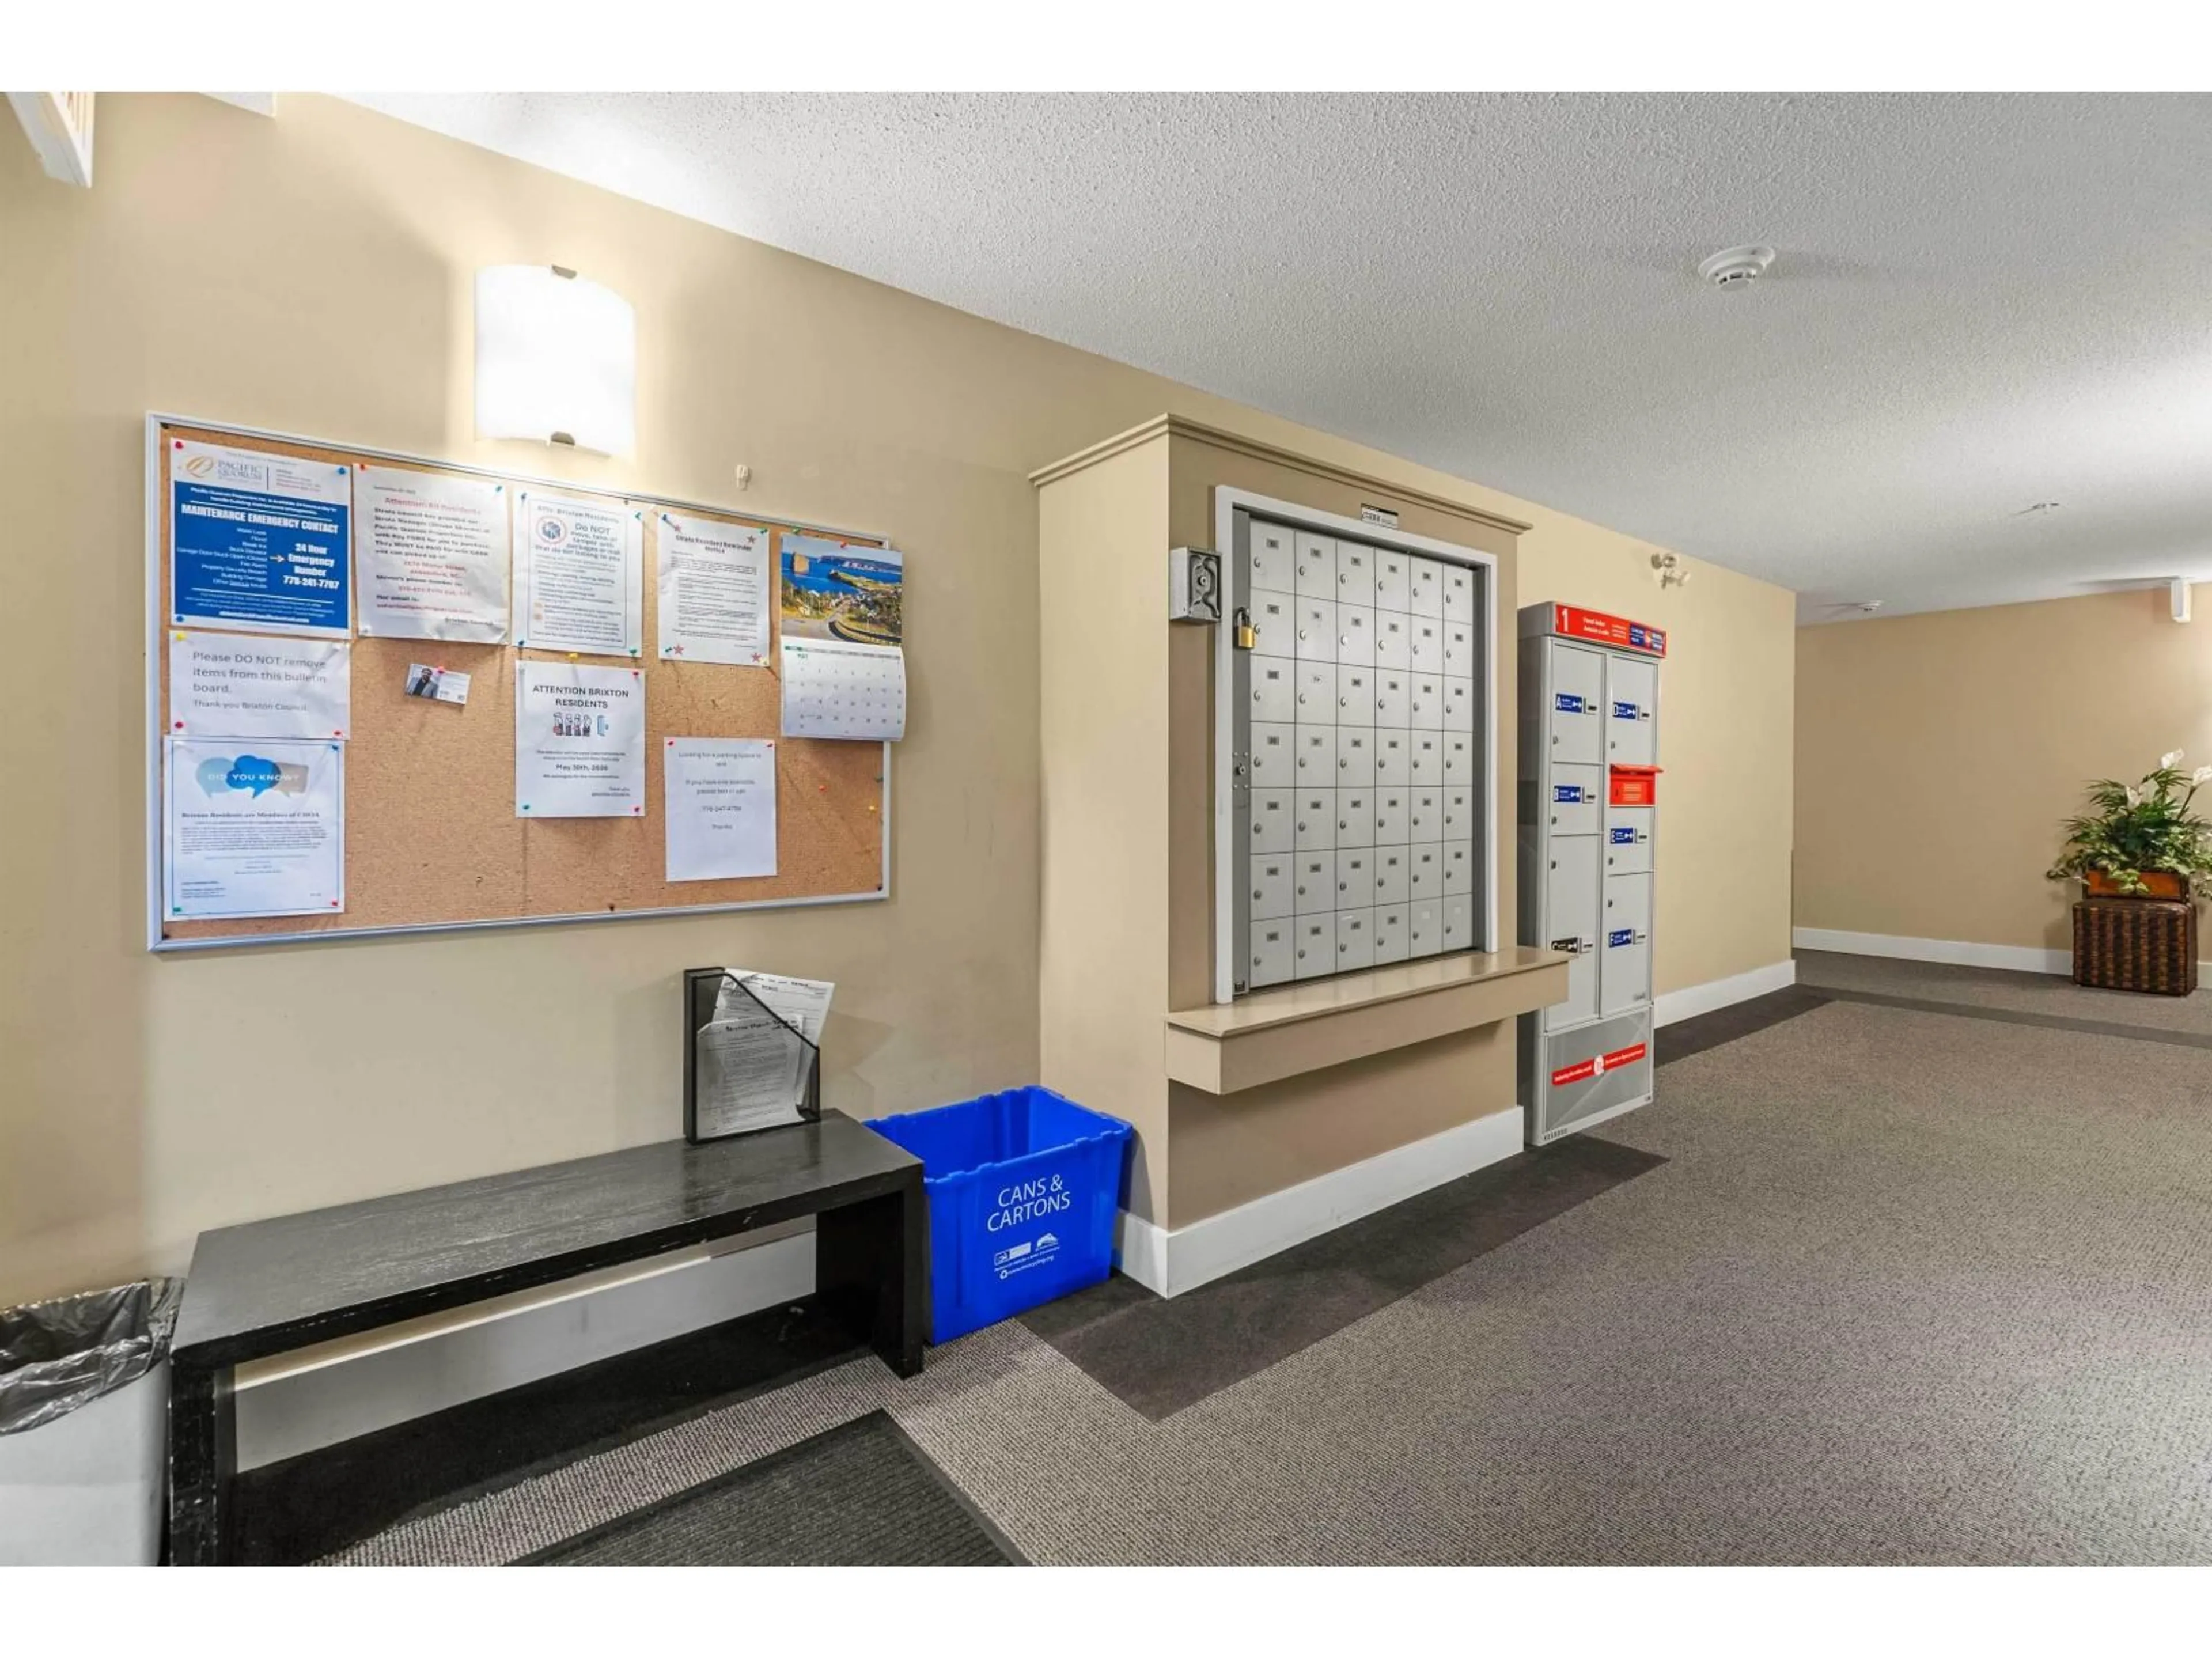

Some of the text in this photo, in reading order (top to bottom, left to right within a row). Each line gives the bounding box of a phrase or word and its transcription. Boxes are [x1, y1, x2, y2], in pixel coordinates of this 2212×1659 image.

[218, 460, 262, 474] PACIFIC
[181, 503, 339, 535] MAINTENANCE EMERGENCY CONTACT
[590, 525, 611, 536] NOT
[295, 543, 327, 555] 24 Hour
[288, 553, 335, 567] Emergency
[294, 565, 327, 577] Number
[1562, 608, 1569, 632] 1
[193, 650, 327, 669] Please DO NOT remove
[193, 668, 327, 684] items from this bulletin
[532, 685, 629, 698] ATTENTION BRIXTON
[194, 699, 221, 708] Thank
[224, 702, 240, 710] you
[555, 698, 608, 709] RESIDENTS
[232, 773, 255, 781] YOU
[998, 1173, 1063, 1207] CANS &
[987, 1191, 1070, 1232] CARTONS
